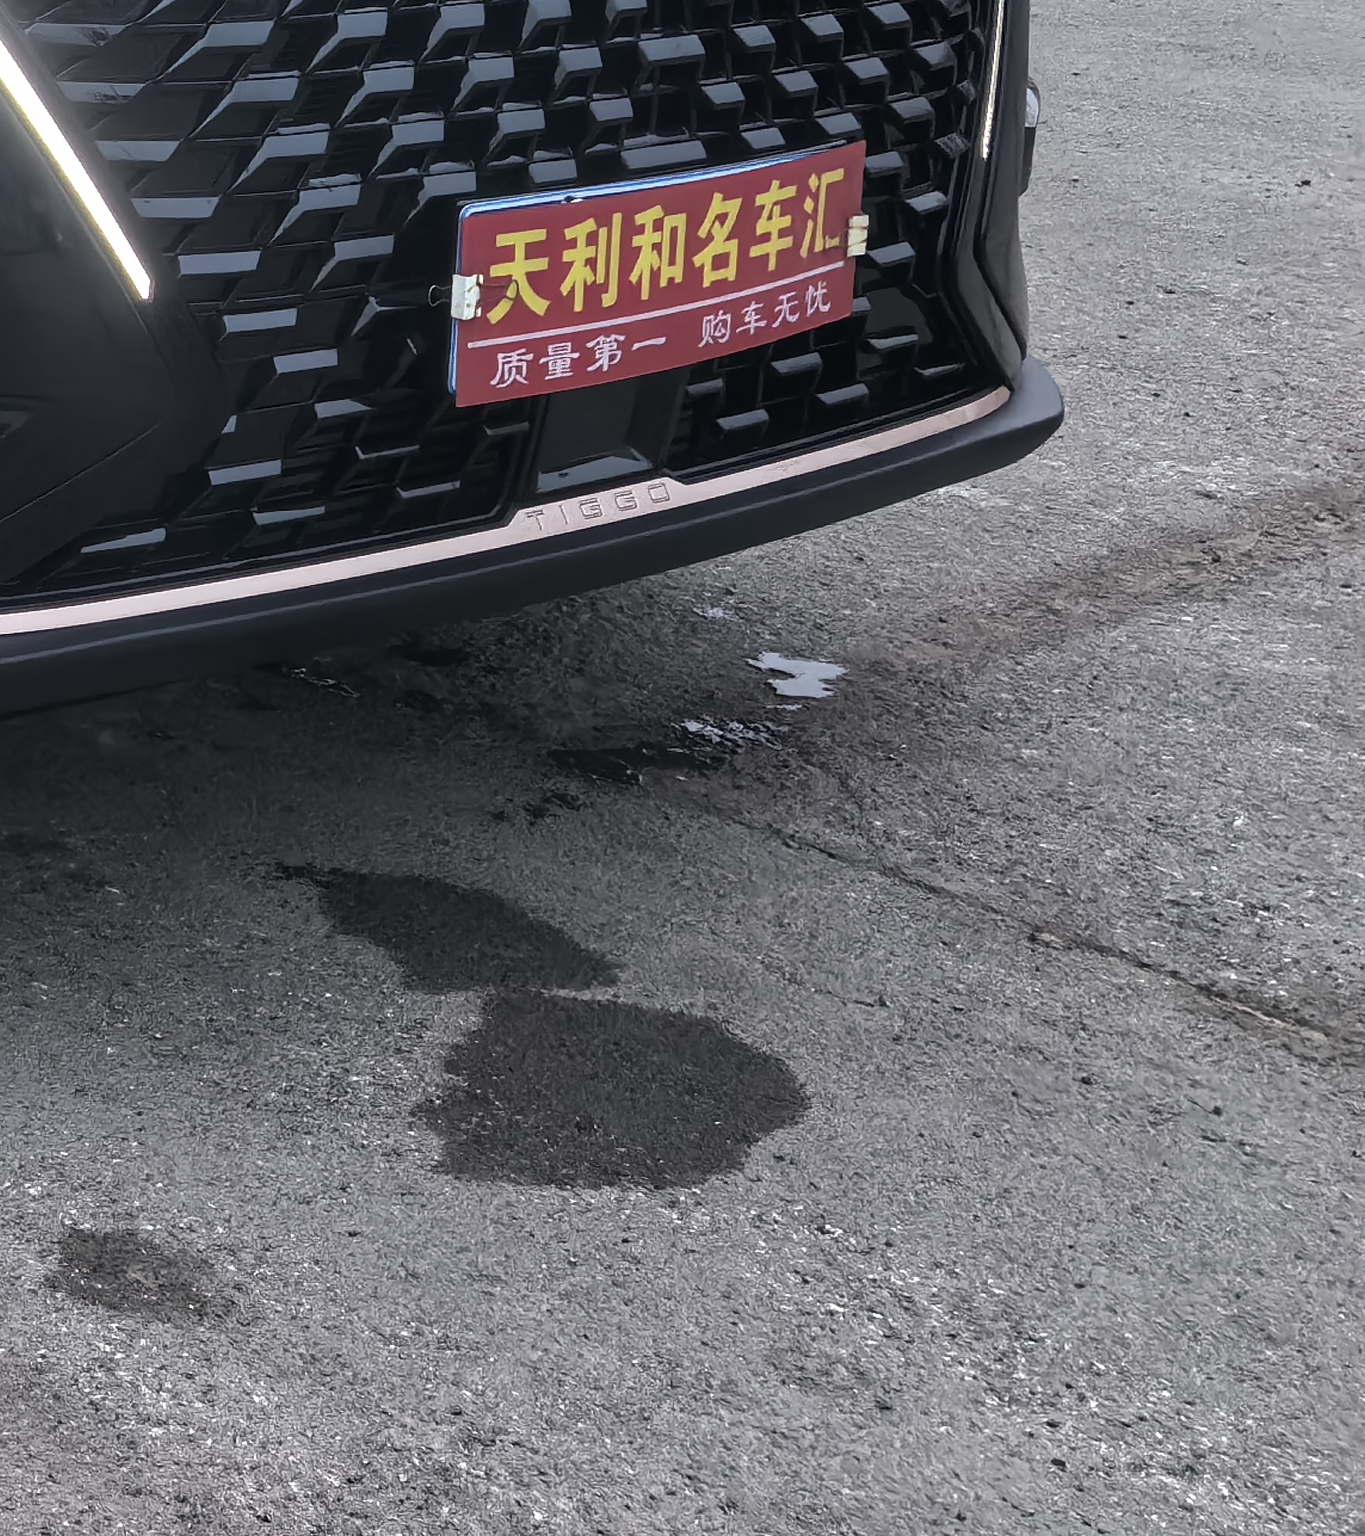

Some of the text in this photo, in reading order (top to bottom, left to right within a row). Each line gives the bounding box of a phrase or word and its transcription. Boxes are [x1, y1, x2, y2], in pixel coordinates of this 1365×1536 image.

[486, 168, 844, 324] 天利和名车汇
[490, 281, 831, 388] 质量第一 购车无忧
[525, 482, 670, 531] TIGGO
